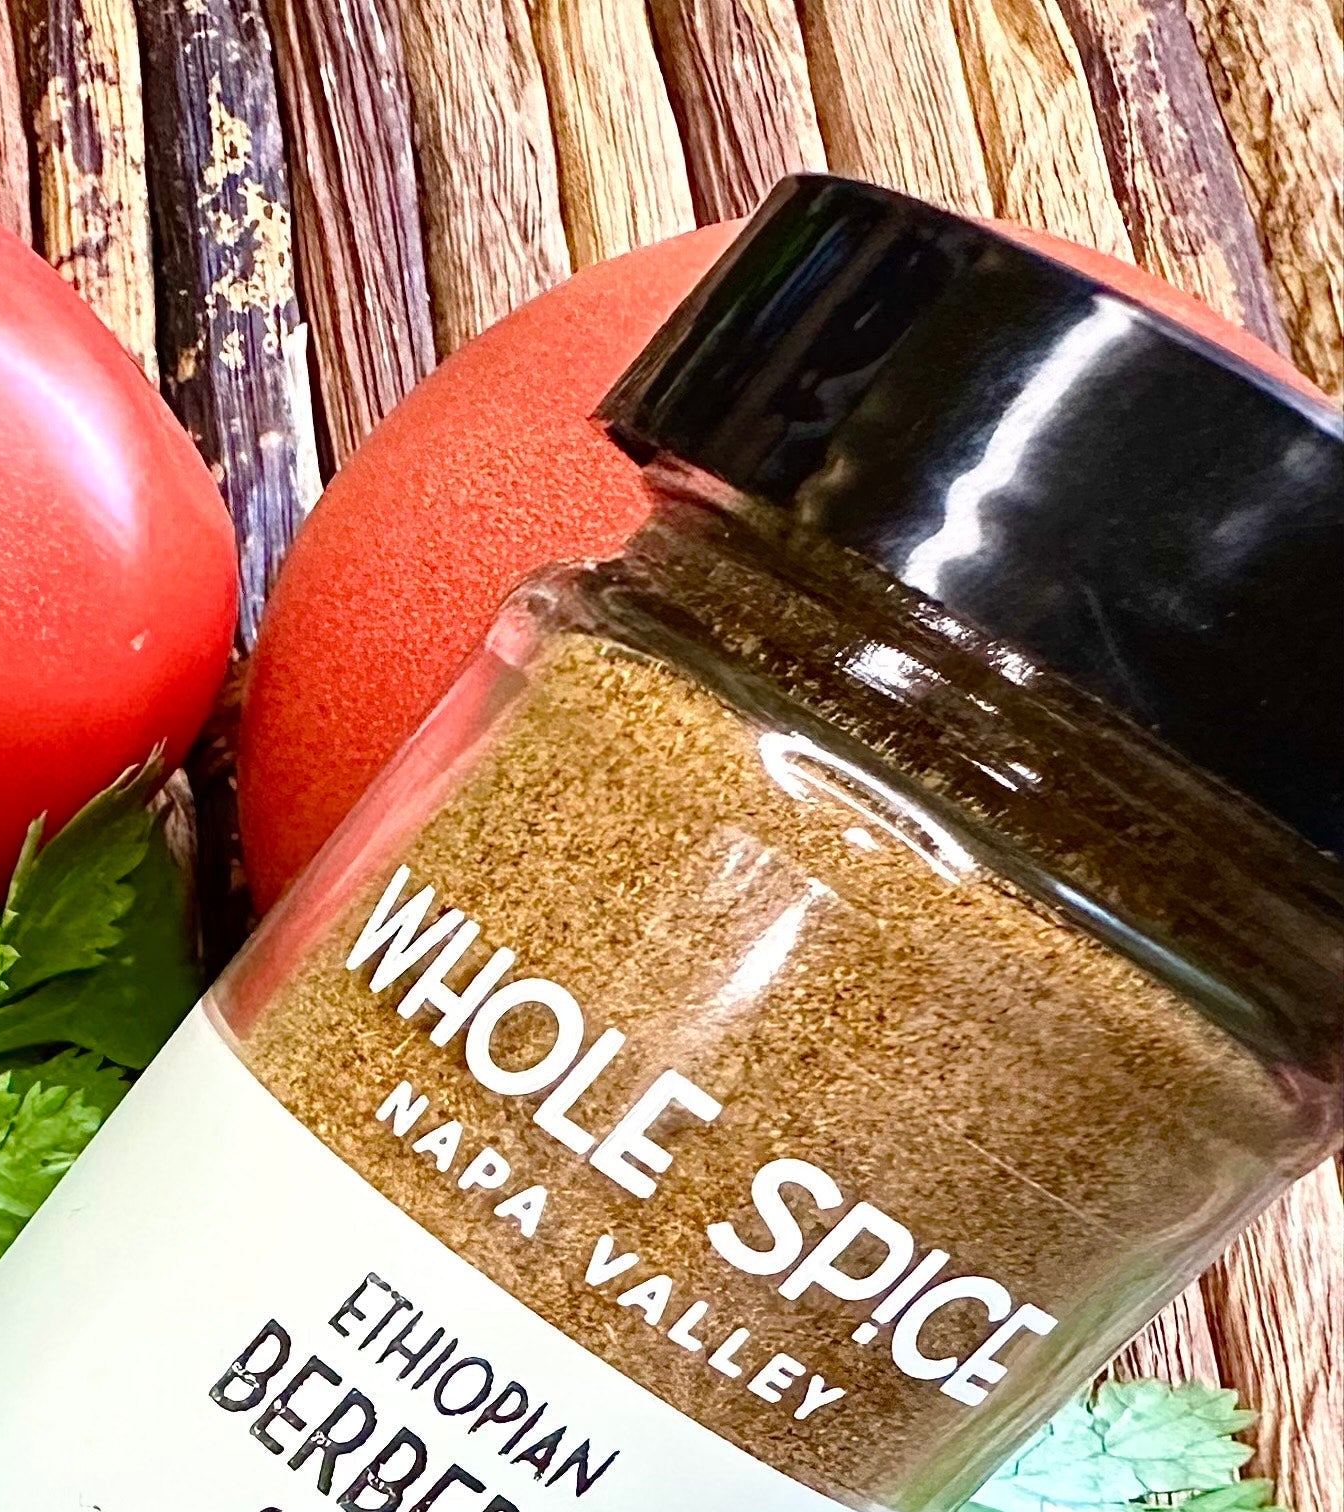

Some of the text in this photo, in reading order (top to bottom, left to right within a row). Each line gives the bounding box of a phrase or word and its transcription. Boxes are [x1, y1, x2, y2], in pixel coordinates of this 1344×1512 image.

[345, 863, 722, 1199] WHOLE
[327, 1271, 620, 1498] ETHIOPIAN
[374, 1080, 847, 1421] NAPA VALLEY
